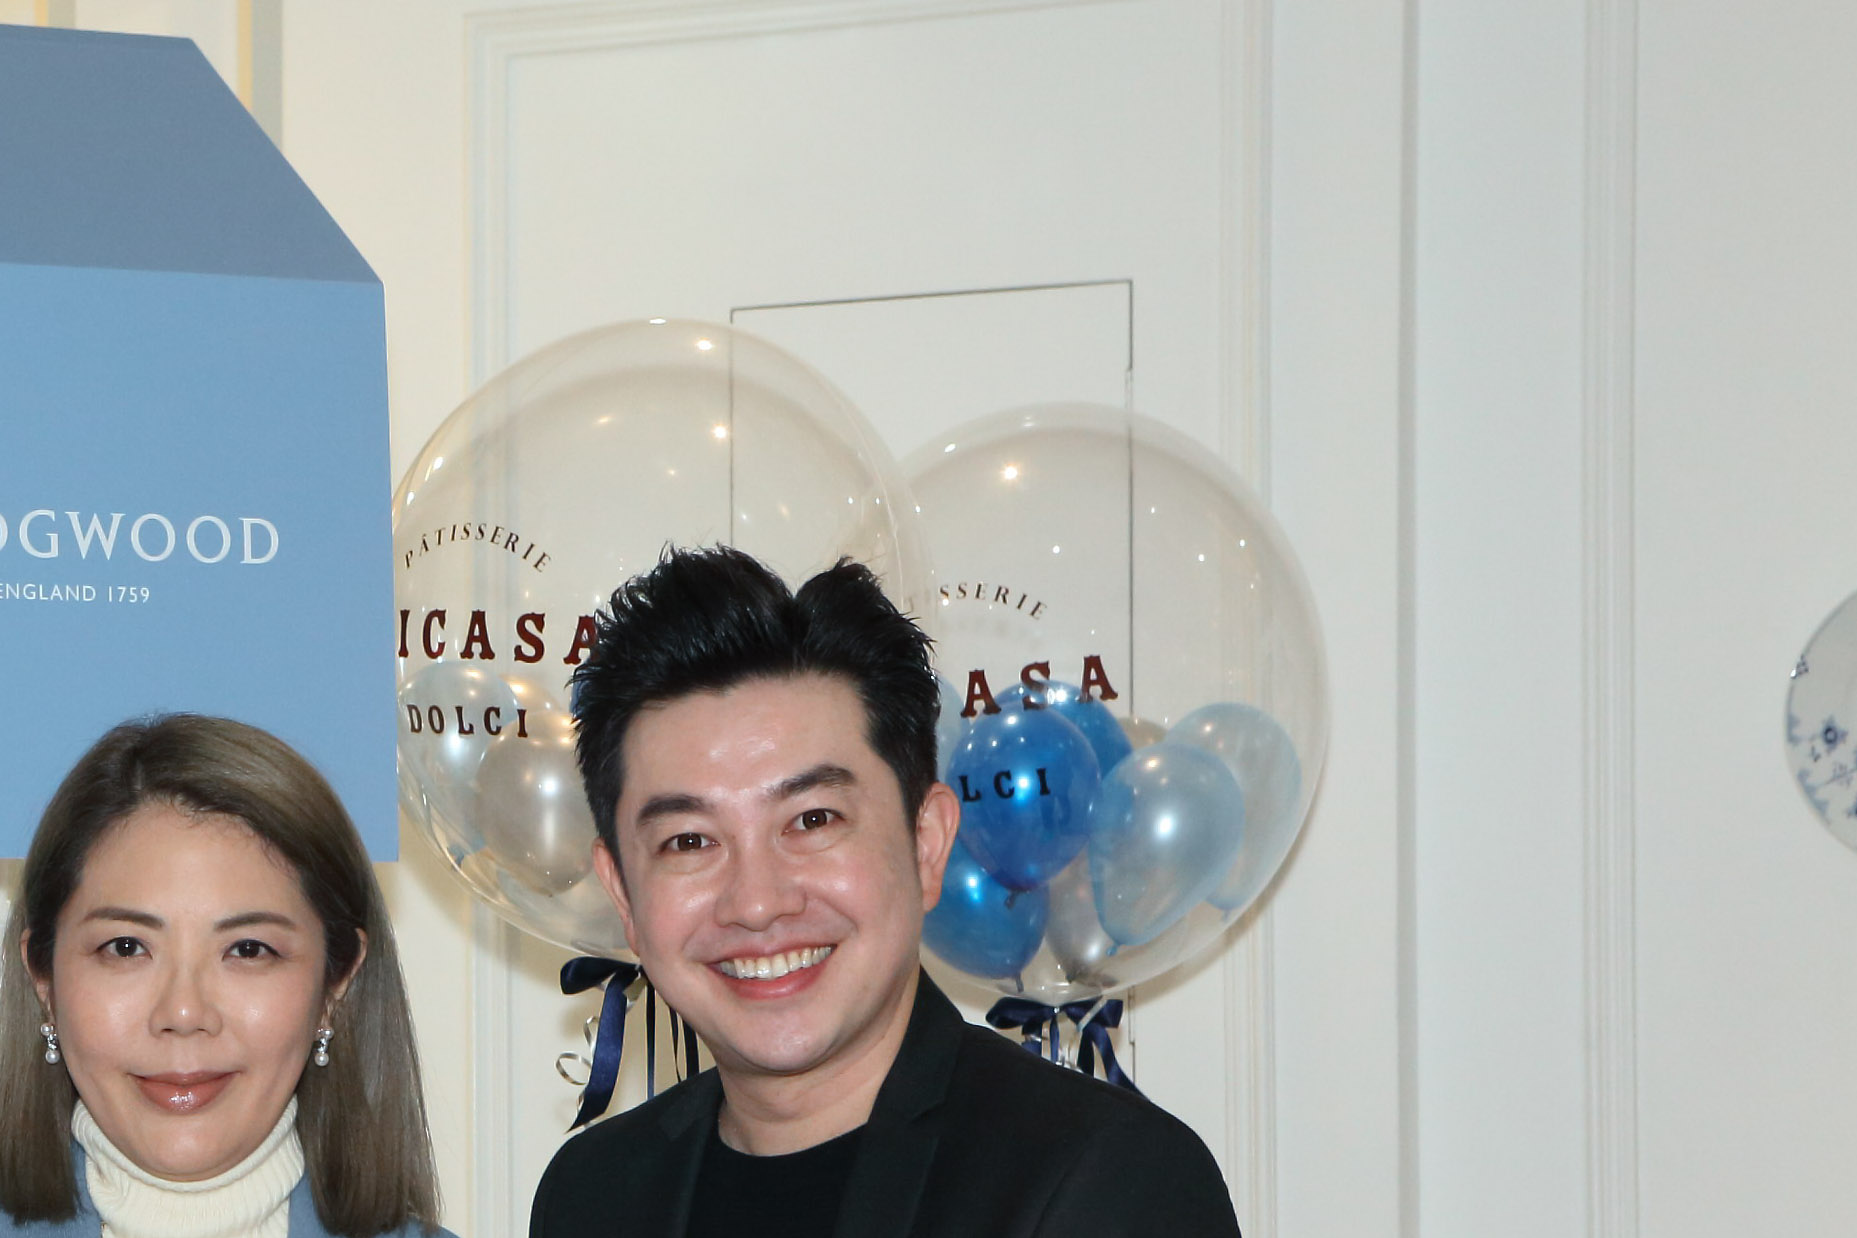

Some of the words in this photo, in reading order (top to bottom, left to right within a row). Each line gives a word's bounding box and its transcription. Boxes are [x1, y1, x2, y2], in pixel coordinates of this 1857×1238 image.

[404, 522, 551, 573] PÂTISSERIE
[108, 586, 150, 603] 1759
[406, 703, 529, 738] DOLCI
